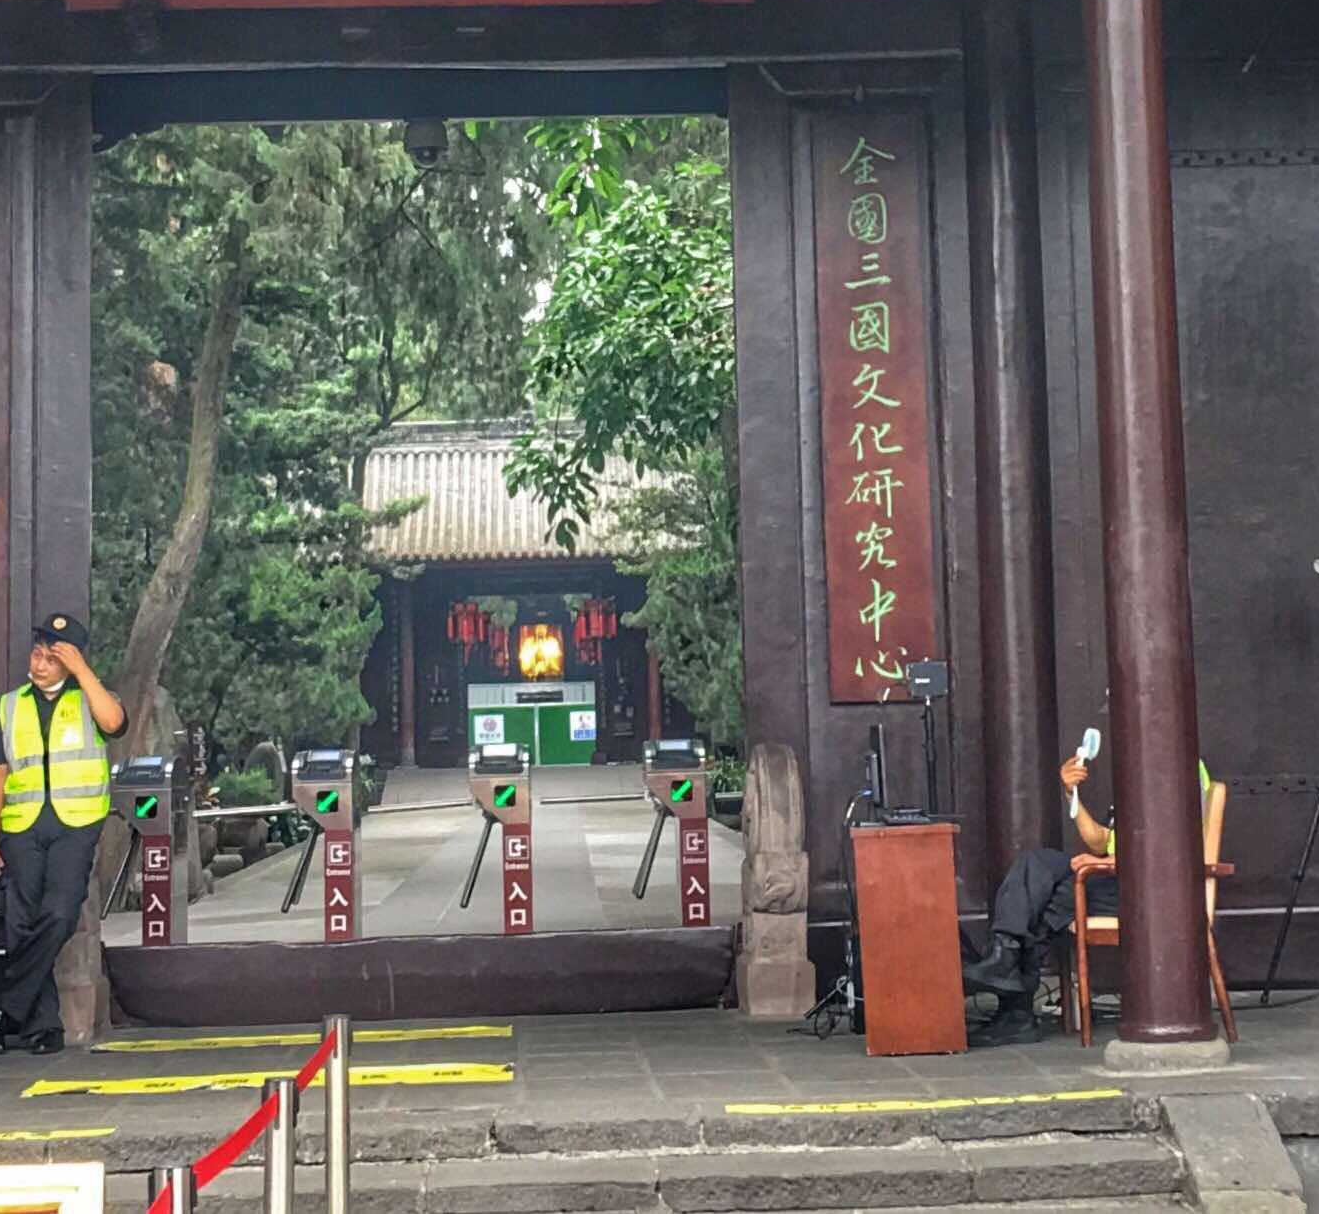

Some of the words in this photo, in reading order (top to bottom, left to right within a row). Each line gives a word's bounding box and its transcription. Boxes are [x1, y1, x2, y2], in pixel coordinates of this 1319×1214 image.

[147, 893, 166, 938] 入口
[329, 887, 348, 932] 入口
[508, 881, 528, 926] 入口
[686, 875, 705, 920] 入口
